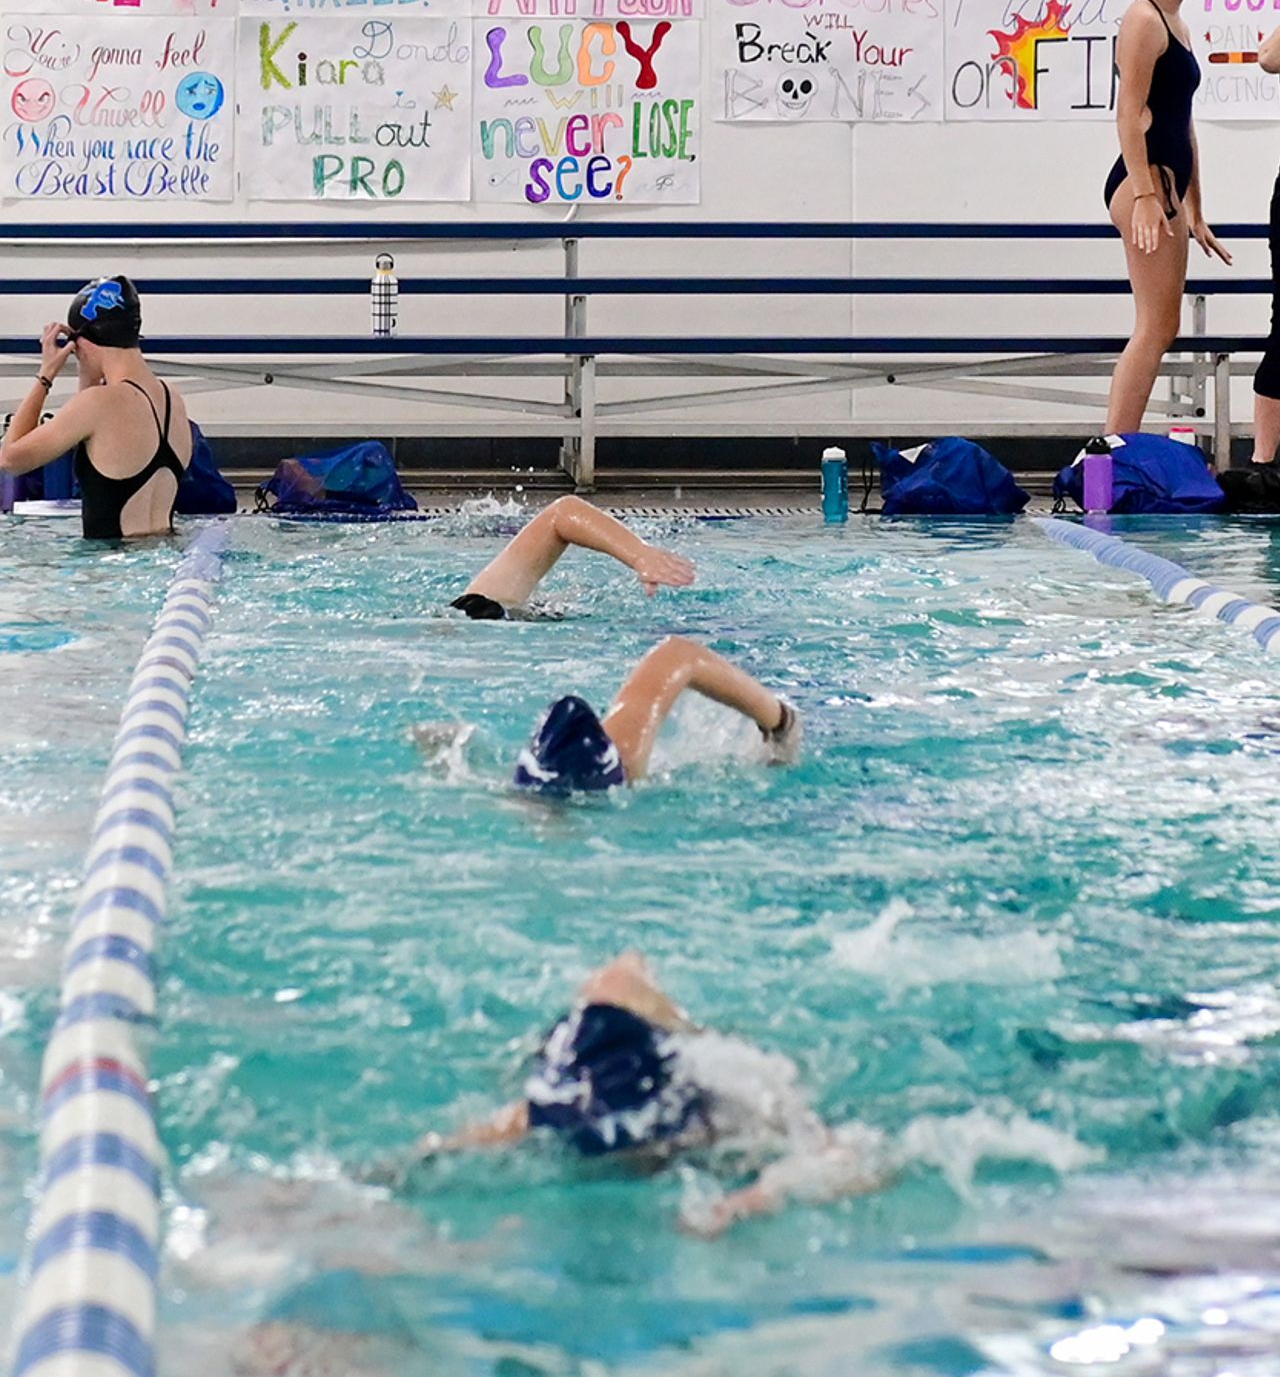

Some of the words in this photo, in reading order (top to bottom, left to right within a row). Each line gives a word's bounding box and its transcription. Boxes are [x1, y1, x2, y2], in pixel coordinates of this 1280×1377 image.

[86, 45, 143, 83] gonna
[154, 29, 207, 72] feel
[258, 21, 386, 91] Kiara
[483, 19, 673, 90] LUCY
[734, 22, 833, 65] Break
[851, 29, 915, 68] Your
[59, 82, 167, 128] Unwell
[951, 56, 1018, 110] on
[1204, 75, 1276, 103] ACING
[3, 114, 76, 158] When
[77, 138, 116, 172] you
[123, 135, 179, 161] race
[181, 120, 221, 164] the
[260, 103, 372, 147] PULL
[375, 110, 433, 149] out
[480, 112, 625, 161] never
[14, 158, 119, 197] Beast
[123, 159, 212, 197] Belle
[311, 154, 407, 199] PRO
[524, 154, 634, 205] see?
